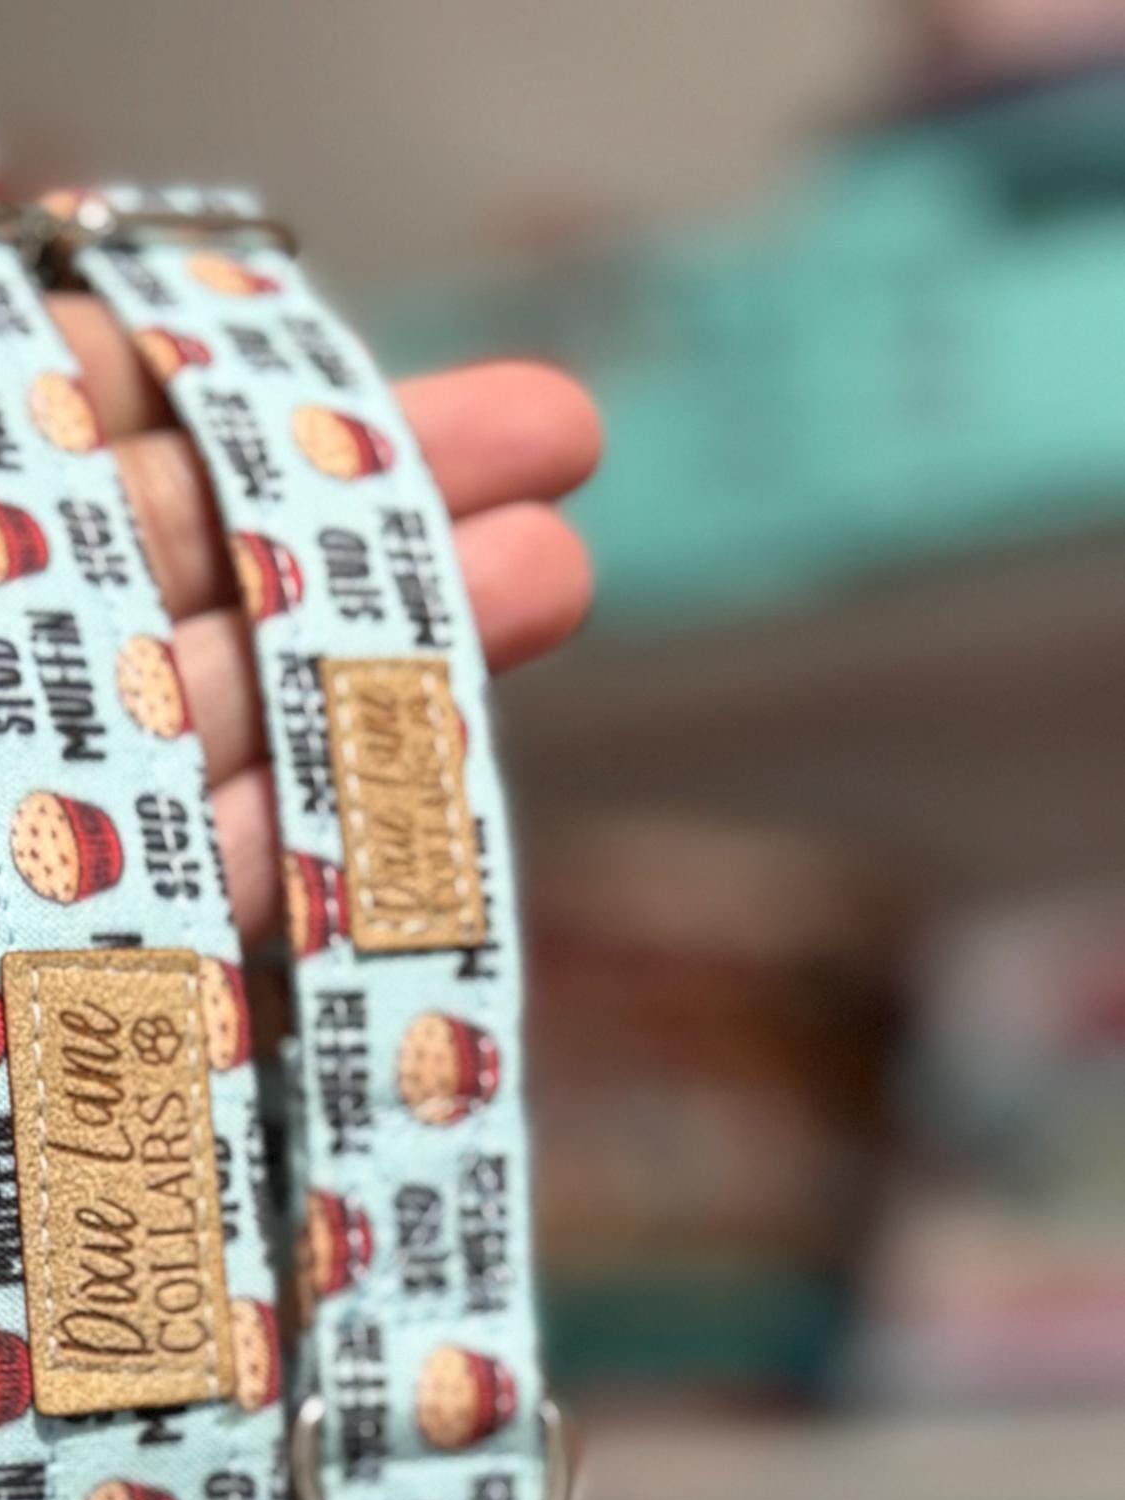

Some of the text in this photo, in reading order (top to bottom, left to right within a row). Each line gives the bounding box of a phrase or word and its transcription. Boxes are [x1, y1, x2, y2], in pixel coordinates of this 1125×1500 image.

[135, 794, 201, 901] STUD
[48, 1000, 135, 1165] Lane
[56, 1198, 153, 1355] Dixie
[136, 1091, 210, 1353] COLLARS
